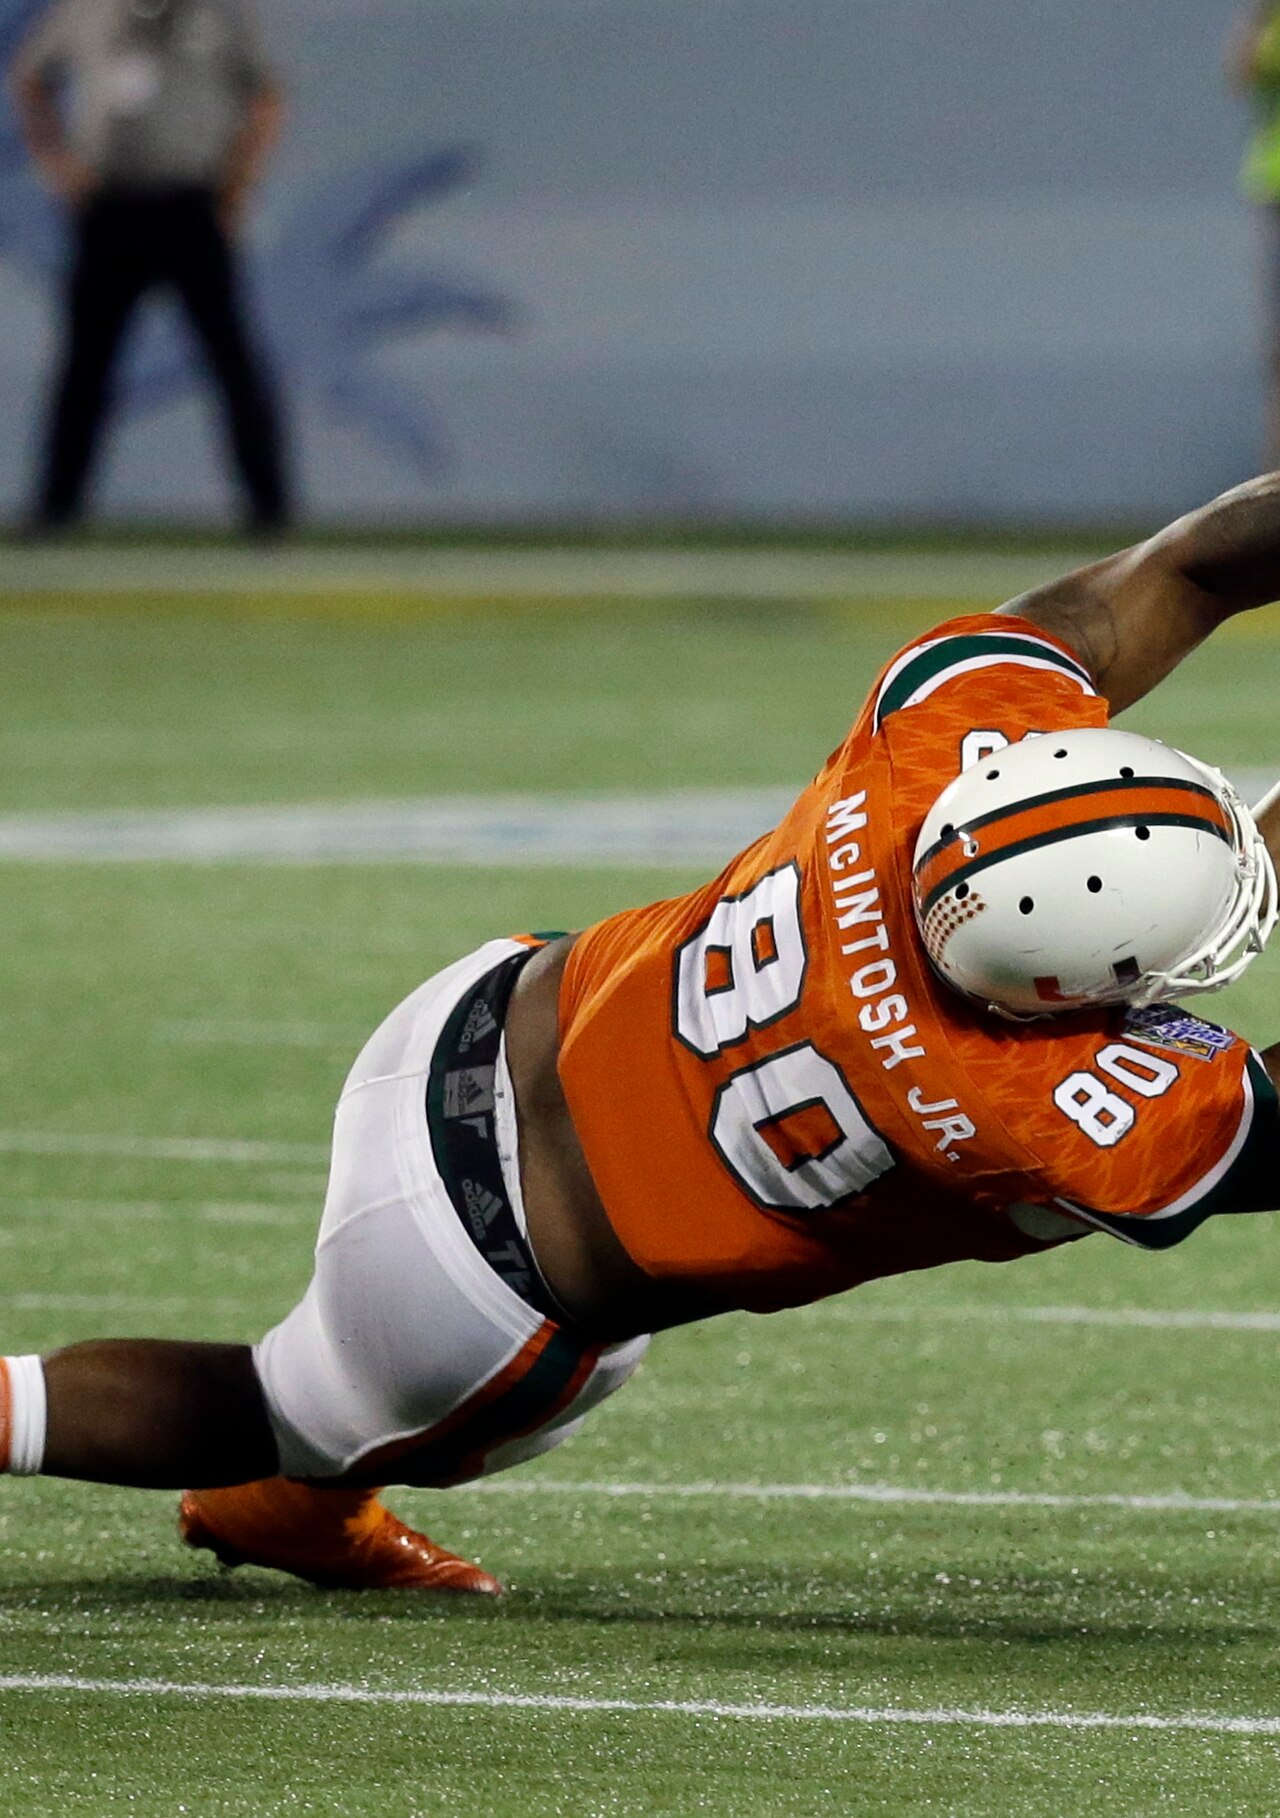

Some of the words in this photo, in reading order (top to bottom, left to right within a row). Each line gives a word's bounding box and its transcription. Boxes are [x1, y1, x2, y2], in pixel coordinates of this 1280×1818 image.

[671, 858, 897, 1212] 80
[907, 1086, 977, 1164] JR.
[1052, 1041, 1181, 1149] 80
[462, 1178, 488, 1241] adidas
